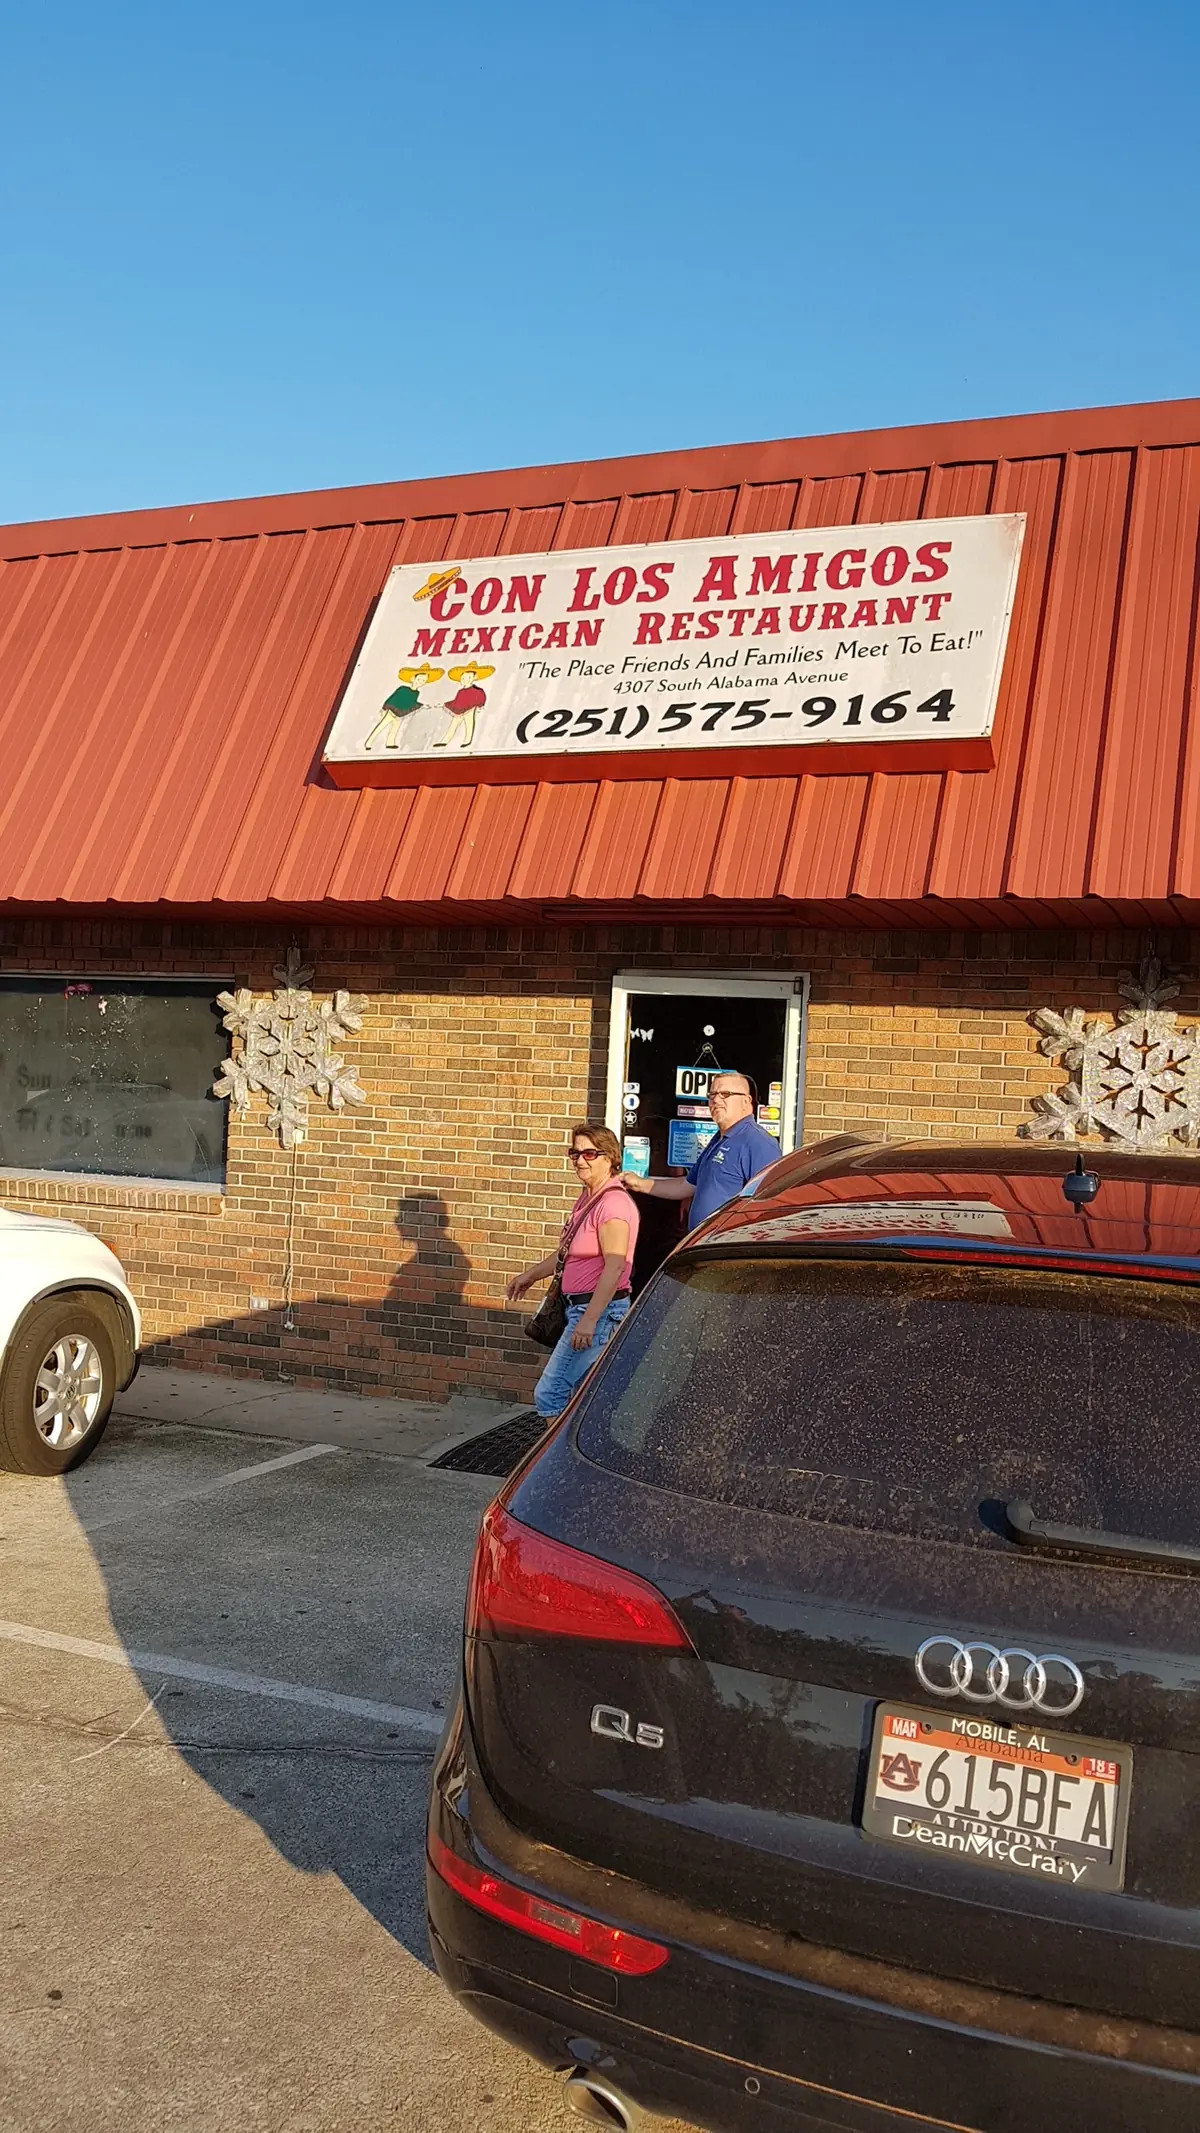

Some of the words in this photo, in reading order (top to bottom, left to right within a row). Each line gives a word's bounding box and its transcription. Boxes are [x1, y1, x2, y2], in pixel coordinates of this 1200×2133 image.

[429, 574, 547, 622] CON
[566, 562, 675, 613] LOS
[693, 541, 953, 602] AMIGOS
[407, 618, 605, 658] MEXICAN
[632, 592, 952, 645] RESTAURANT
[518, 661, 561, 679] "The
[567, 659, 615, 677] Place
[621, 653, 690, 674] Friends
[695, 649, 740, 670] And
[744, 645, 824, 667] Families
[834, 640, 889, 660] Meet
[897, 635, 922, 654] To
[929, 630, 984, 652] Eat!"
[612, 679, 654, 694] 4307
[657, 677, 702, 692] South
[706, 675, 778, 691] Alabama
[784, 671, 849, 686] Avenue
[591, 1703, 664, 1748] Q5
[891, 1718, 918, 1739] MAR
[951, 1718, 1023, 1747] MOBILE,
[1027, 1734, 1050, 1753] AL
[955, 1734, 1045, 1764] Alabama
[925, 1749, 1109, 1848] 615BFA
